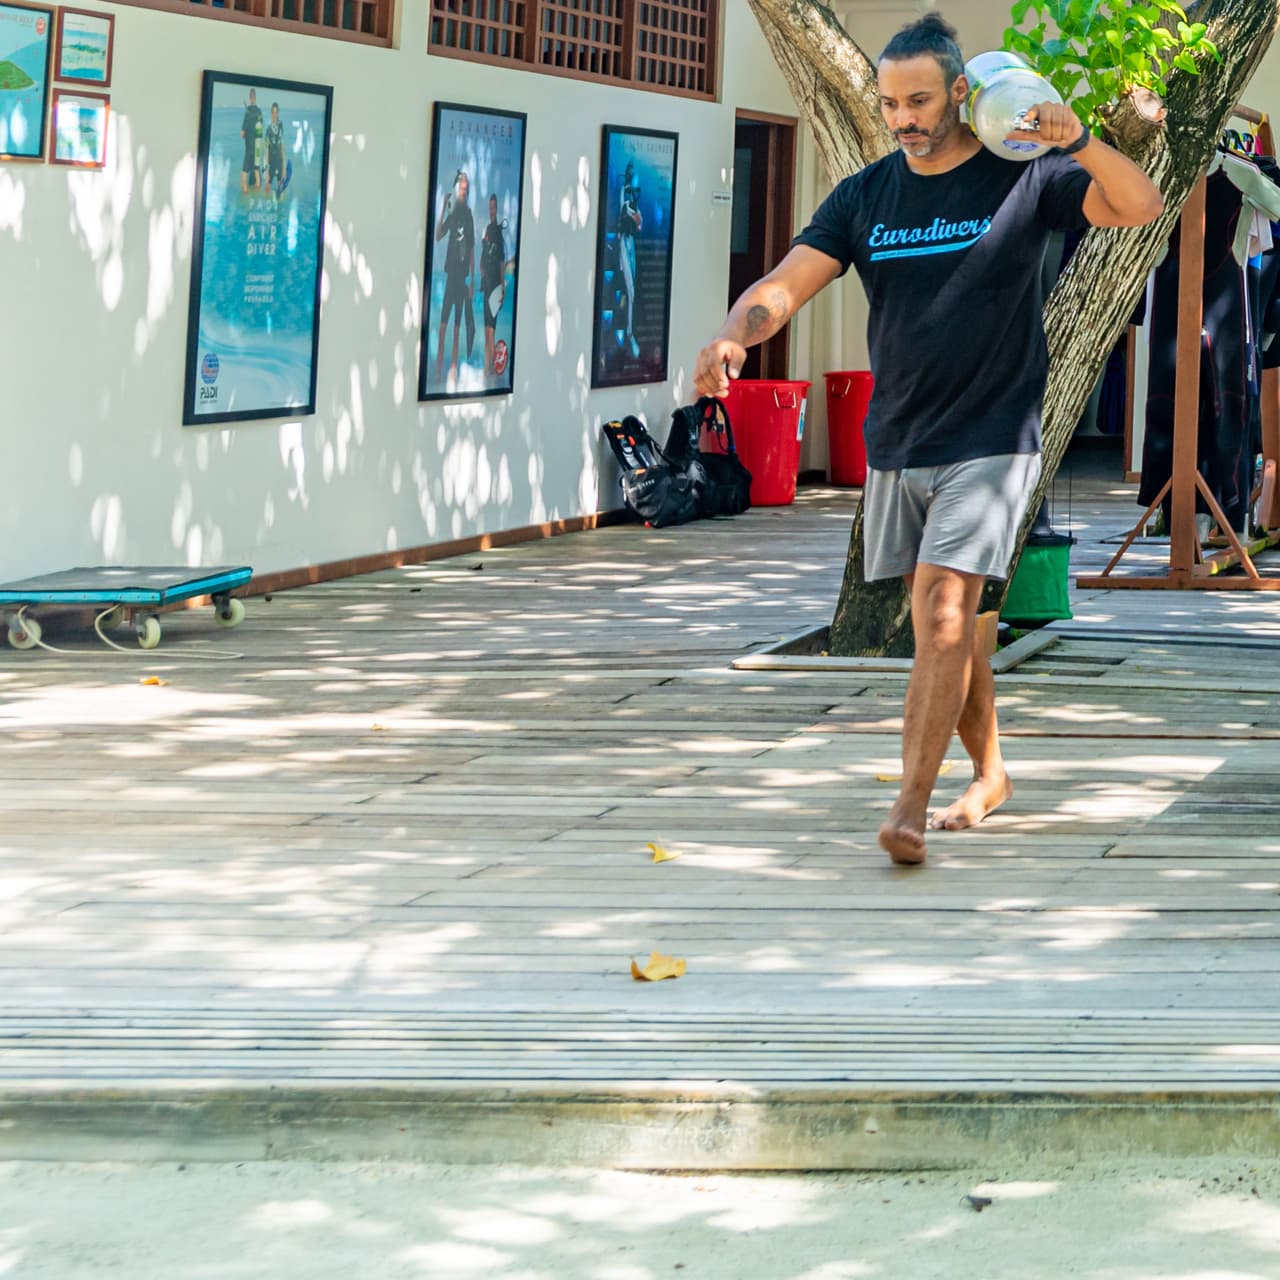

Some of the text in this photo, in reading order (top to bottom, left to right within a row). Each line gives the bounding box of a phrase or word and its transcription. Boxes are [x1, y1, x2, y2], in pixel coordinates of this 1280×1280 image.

[247, 225, 277, 240] AIR
[868, 215, 992, 248] Eurodivers
[246, 243, 276, 256] DIVER
